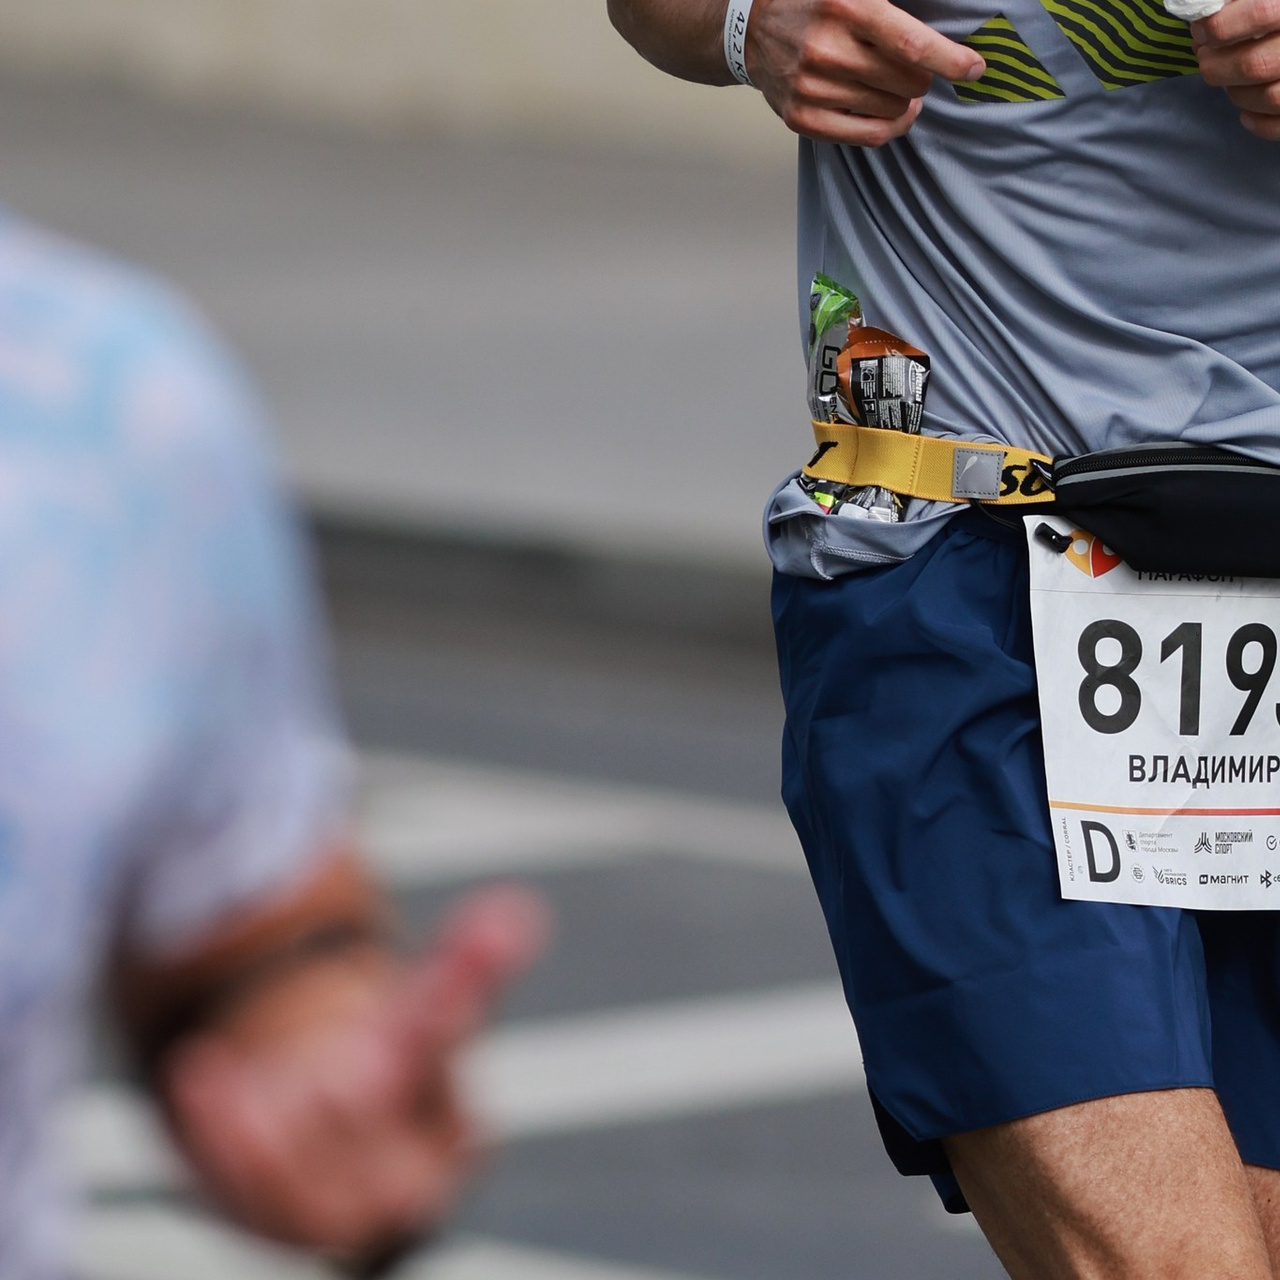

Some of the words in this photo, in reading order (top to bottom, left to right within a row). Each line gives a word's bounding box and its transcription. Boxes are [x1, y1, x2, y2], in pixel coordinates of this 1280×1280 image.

[732, 11, 745, 54] 42,2
[820, 345, 841, 395] GO
[1128, 754, 1280, 789] ВЛАДИМИР
[1080, 820, 1121, 883] D
[1215, 829, 1254, 842] МОСКОВСКИЙ
[1215, 843, 1233, 854] СПОРТ
[1066, 850, 1075, 882] КЛАСТЕР
[1164, 876, 1188, 886] BRICS
